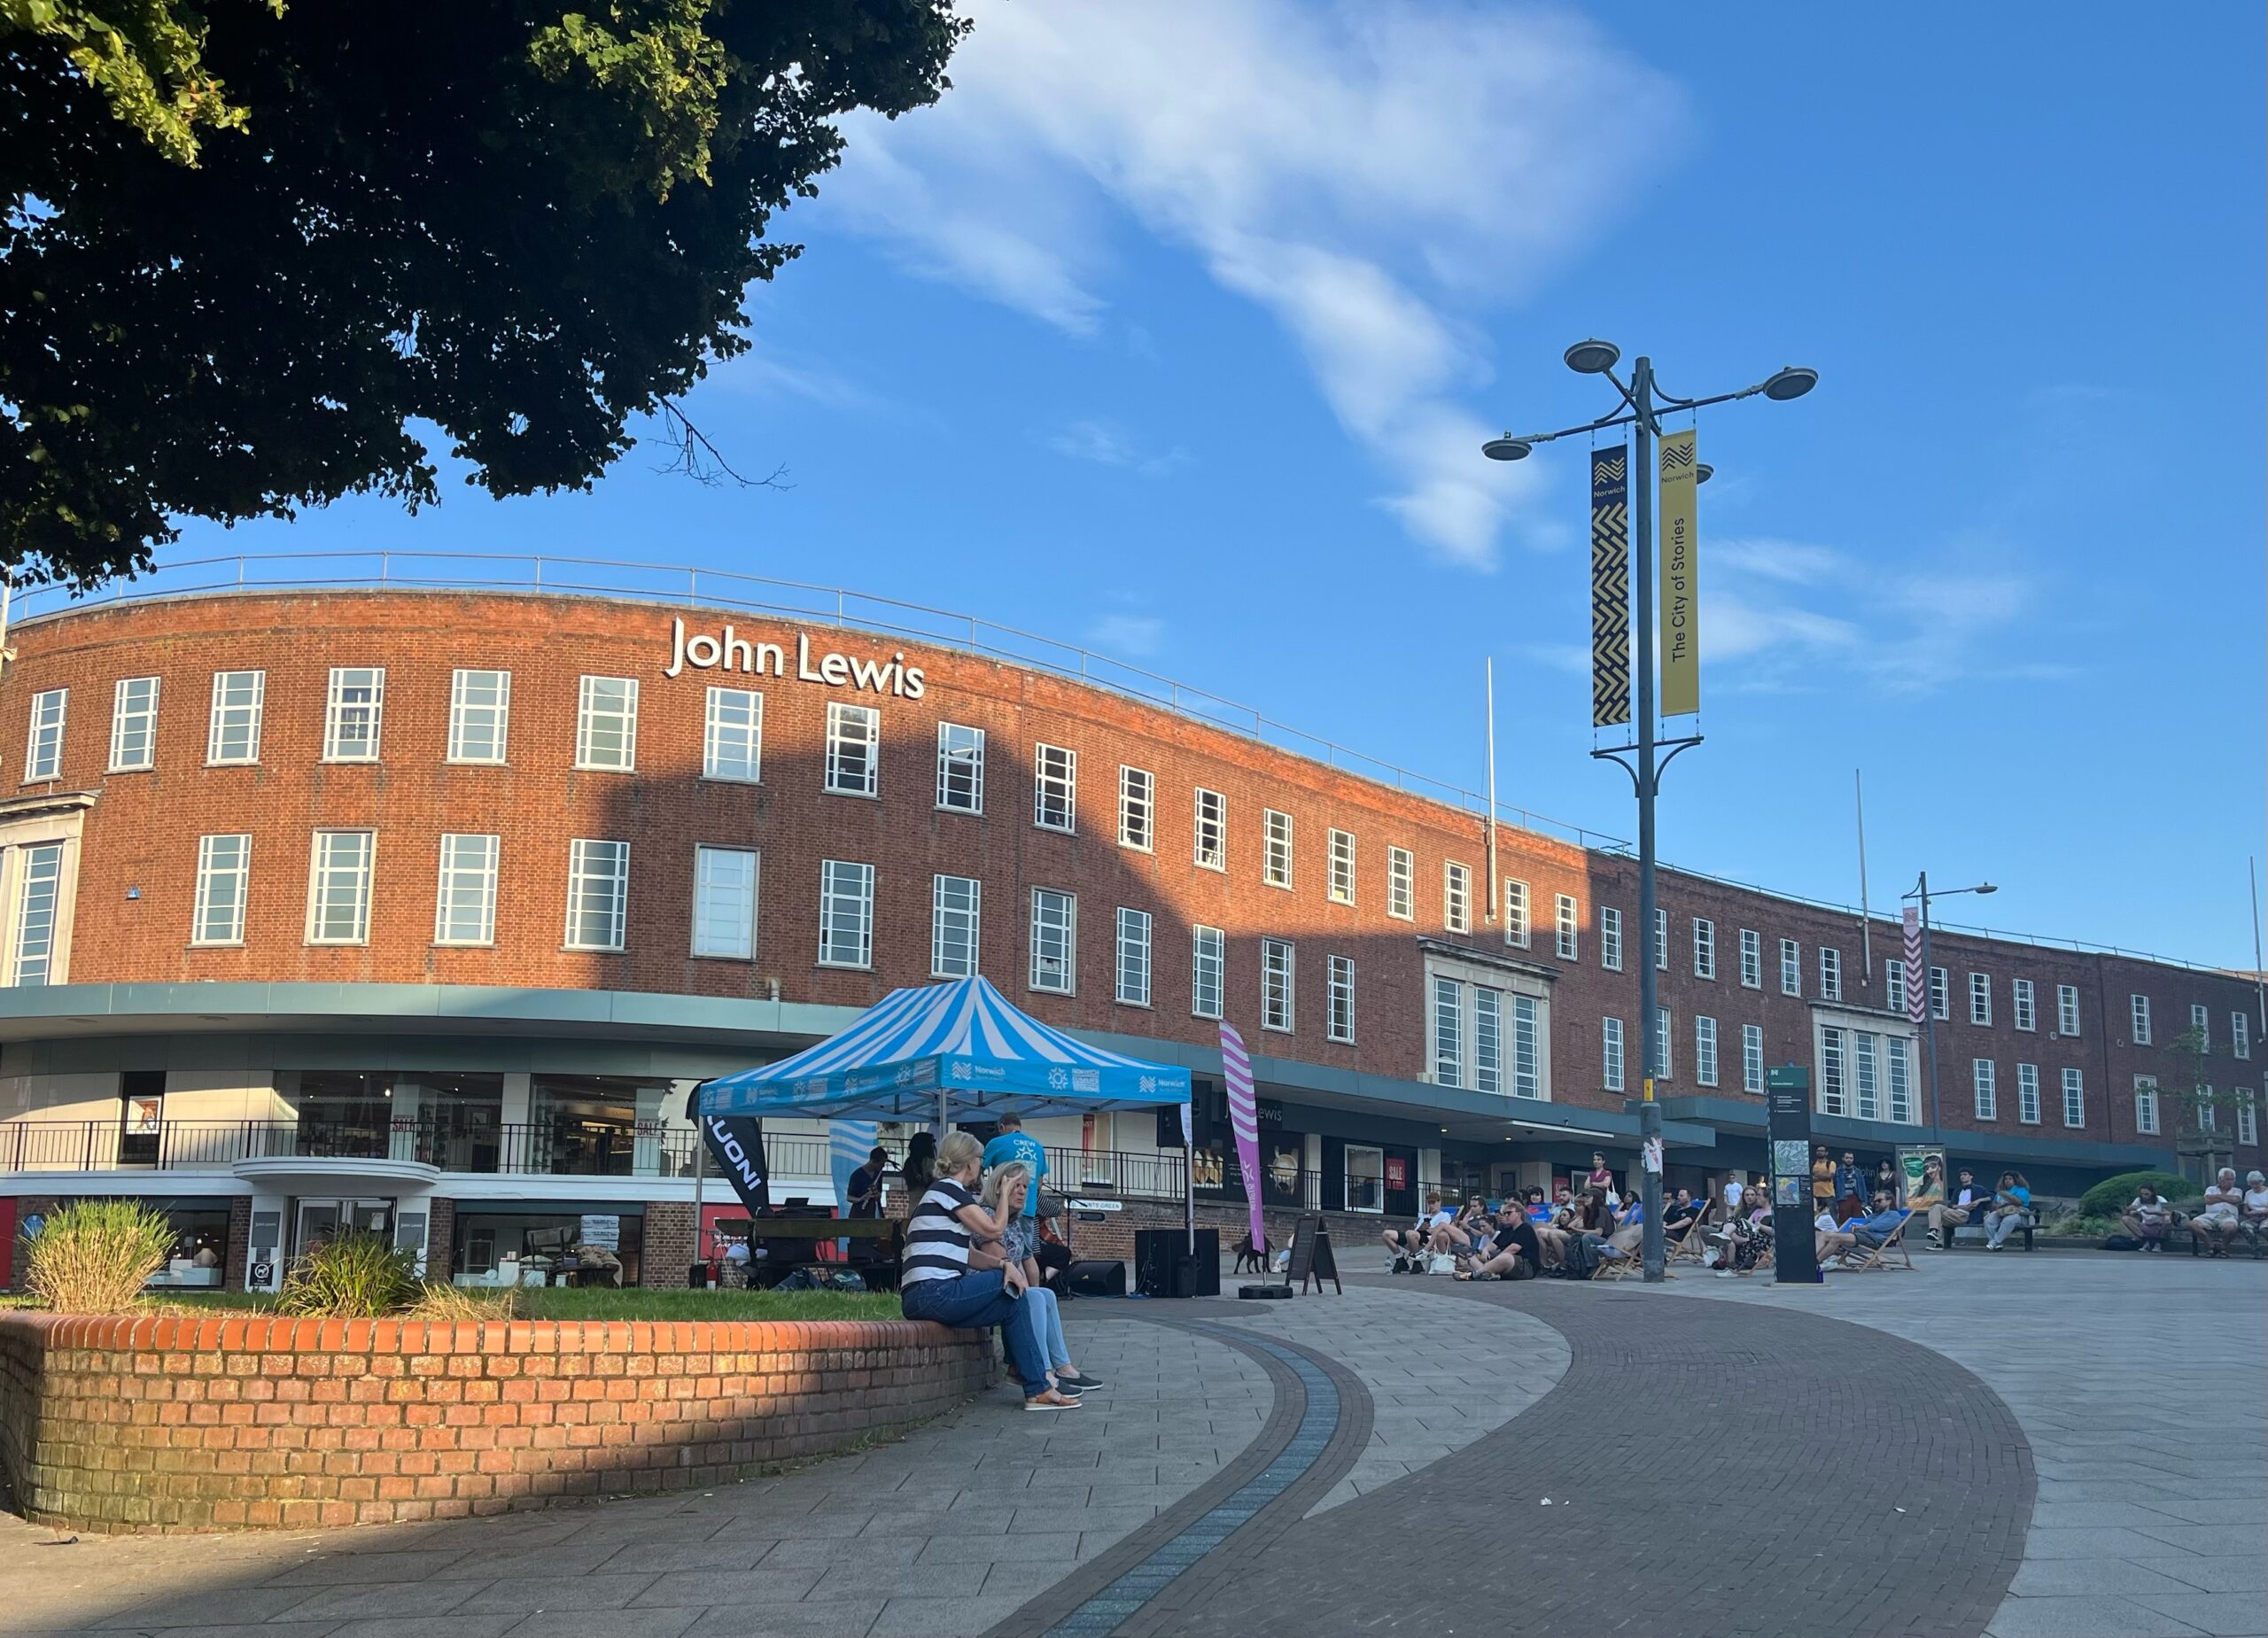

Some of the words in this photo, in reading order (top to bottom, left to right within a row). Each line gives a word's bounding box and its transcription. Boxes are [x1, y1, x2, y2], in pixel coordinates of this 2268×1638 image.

[1661, 471, 1694, 485] Norwich
[1593, 485, 1626, 498] Norwich
[1671, 517, 1685, 571] Stories
[1671, 575, 1685, 591] of
[1672, 595, 1689, 628] City
[1672, 632, 1686, 663] The
[664, 616, 784, 679] John
[798, 630, 926, 700] Lewis
[975, 1065, 1006, 1075] Norwich
[1256, 1106, 1282, 1122] ewis
[637, 1122, 660, 1136] SALE
[706, 1115, 762, 1191] UONI
[1388, 1166, 1403, 1181] SALE
